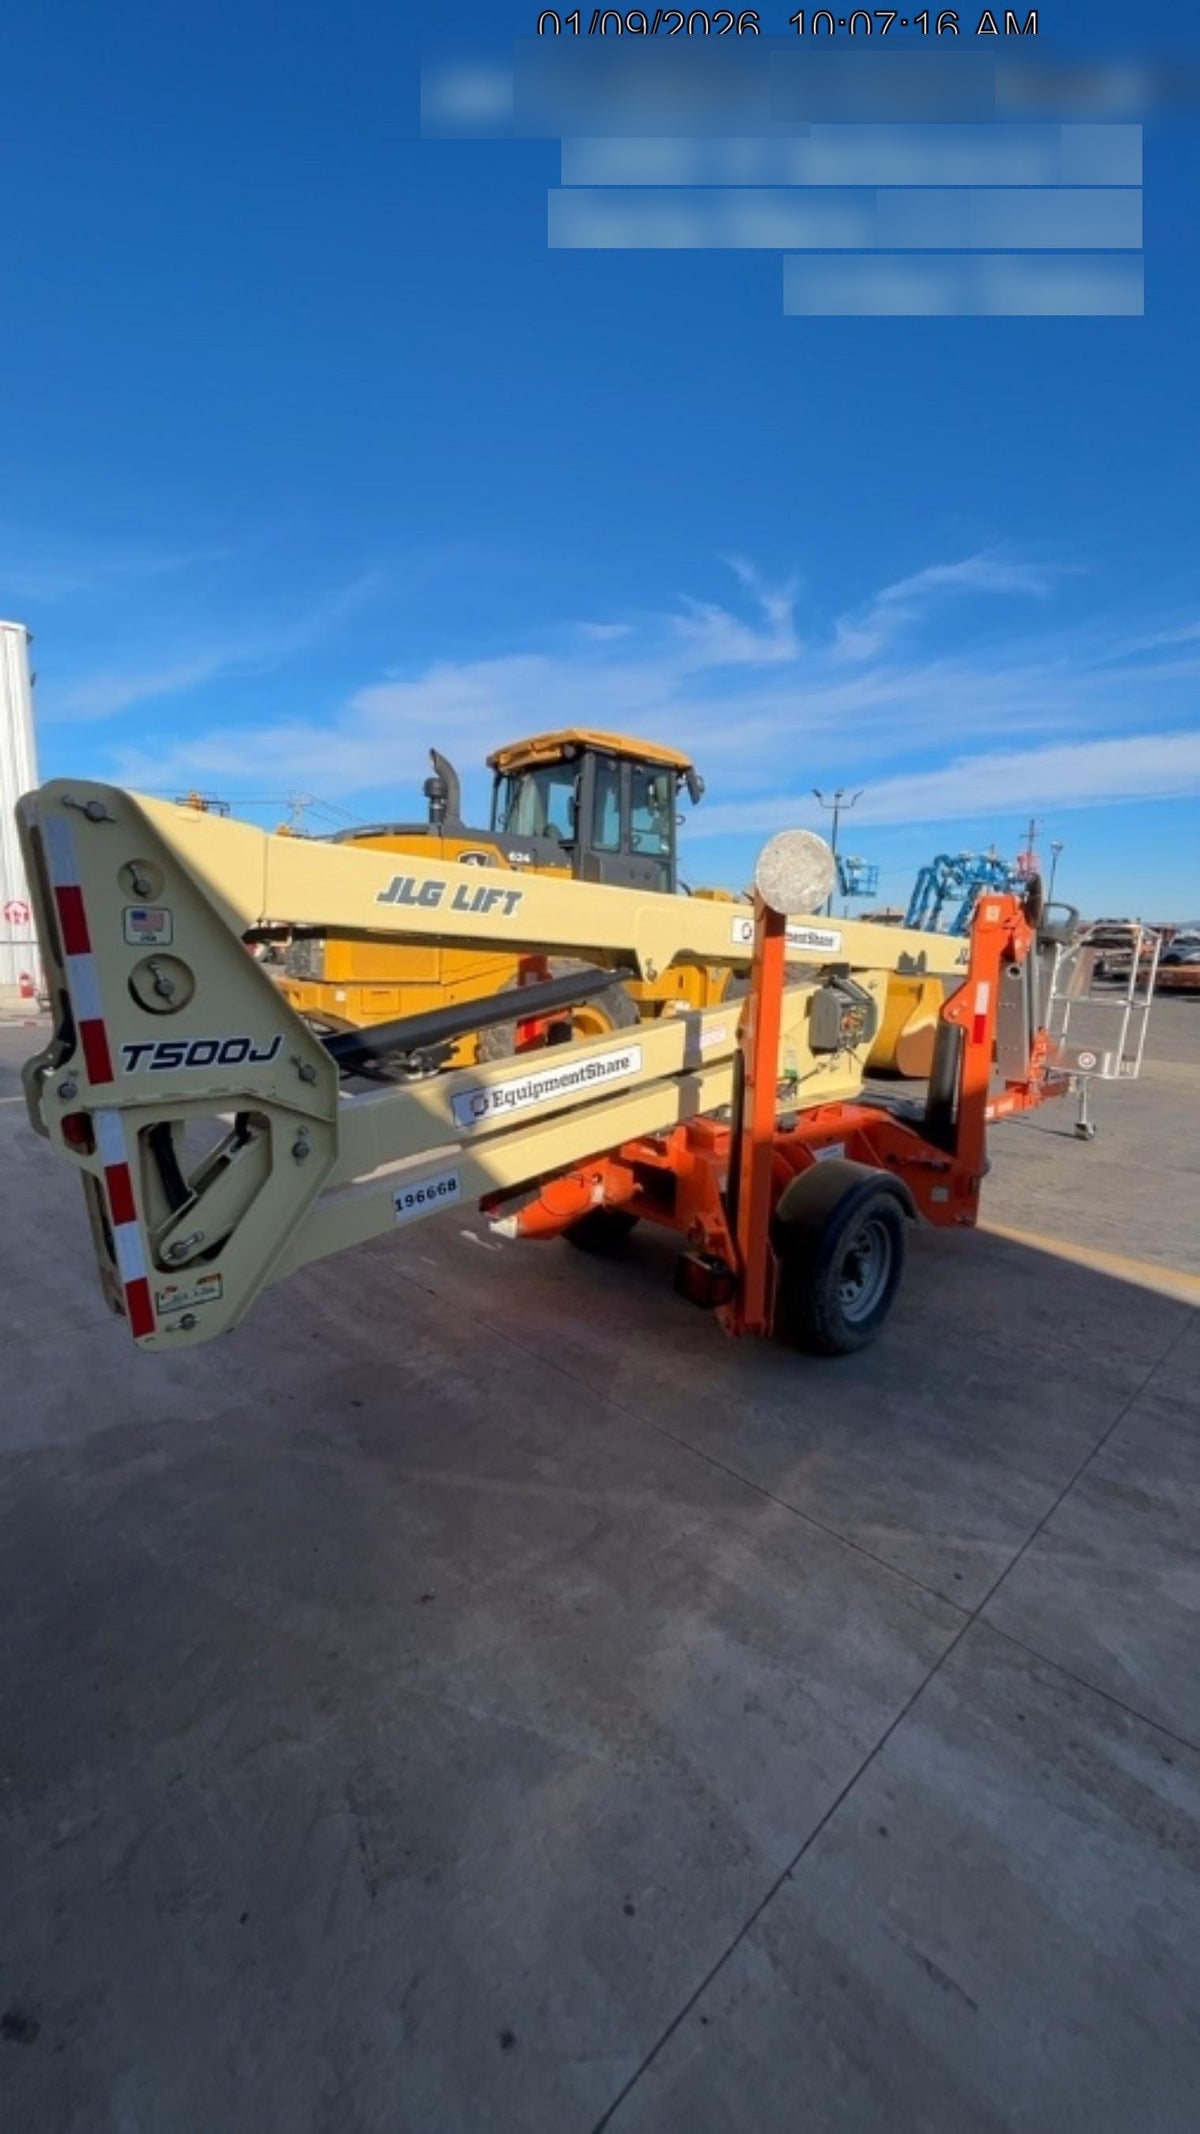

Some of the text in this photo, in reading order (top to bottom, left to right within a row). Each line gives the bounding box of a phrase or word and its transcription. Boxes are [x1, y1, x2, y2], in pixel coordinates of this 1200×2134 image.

[376, 876, 523, 916] JLG LIFT
[122, 1035, 283, 1073] T500J
[492, 1056, 630, 1108] EquipmentShare
[395, 1178, 457, 1212] 196668
